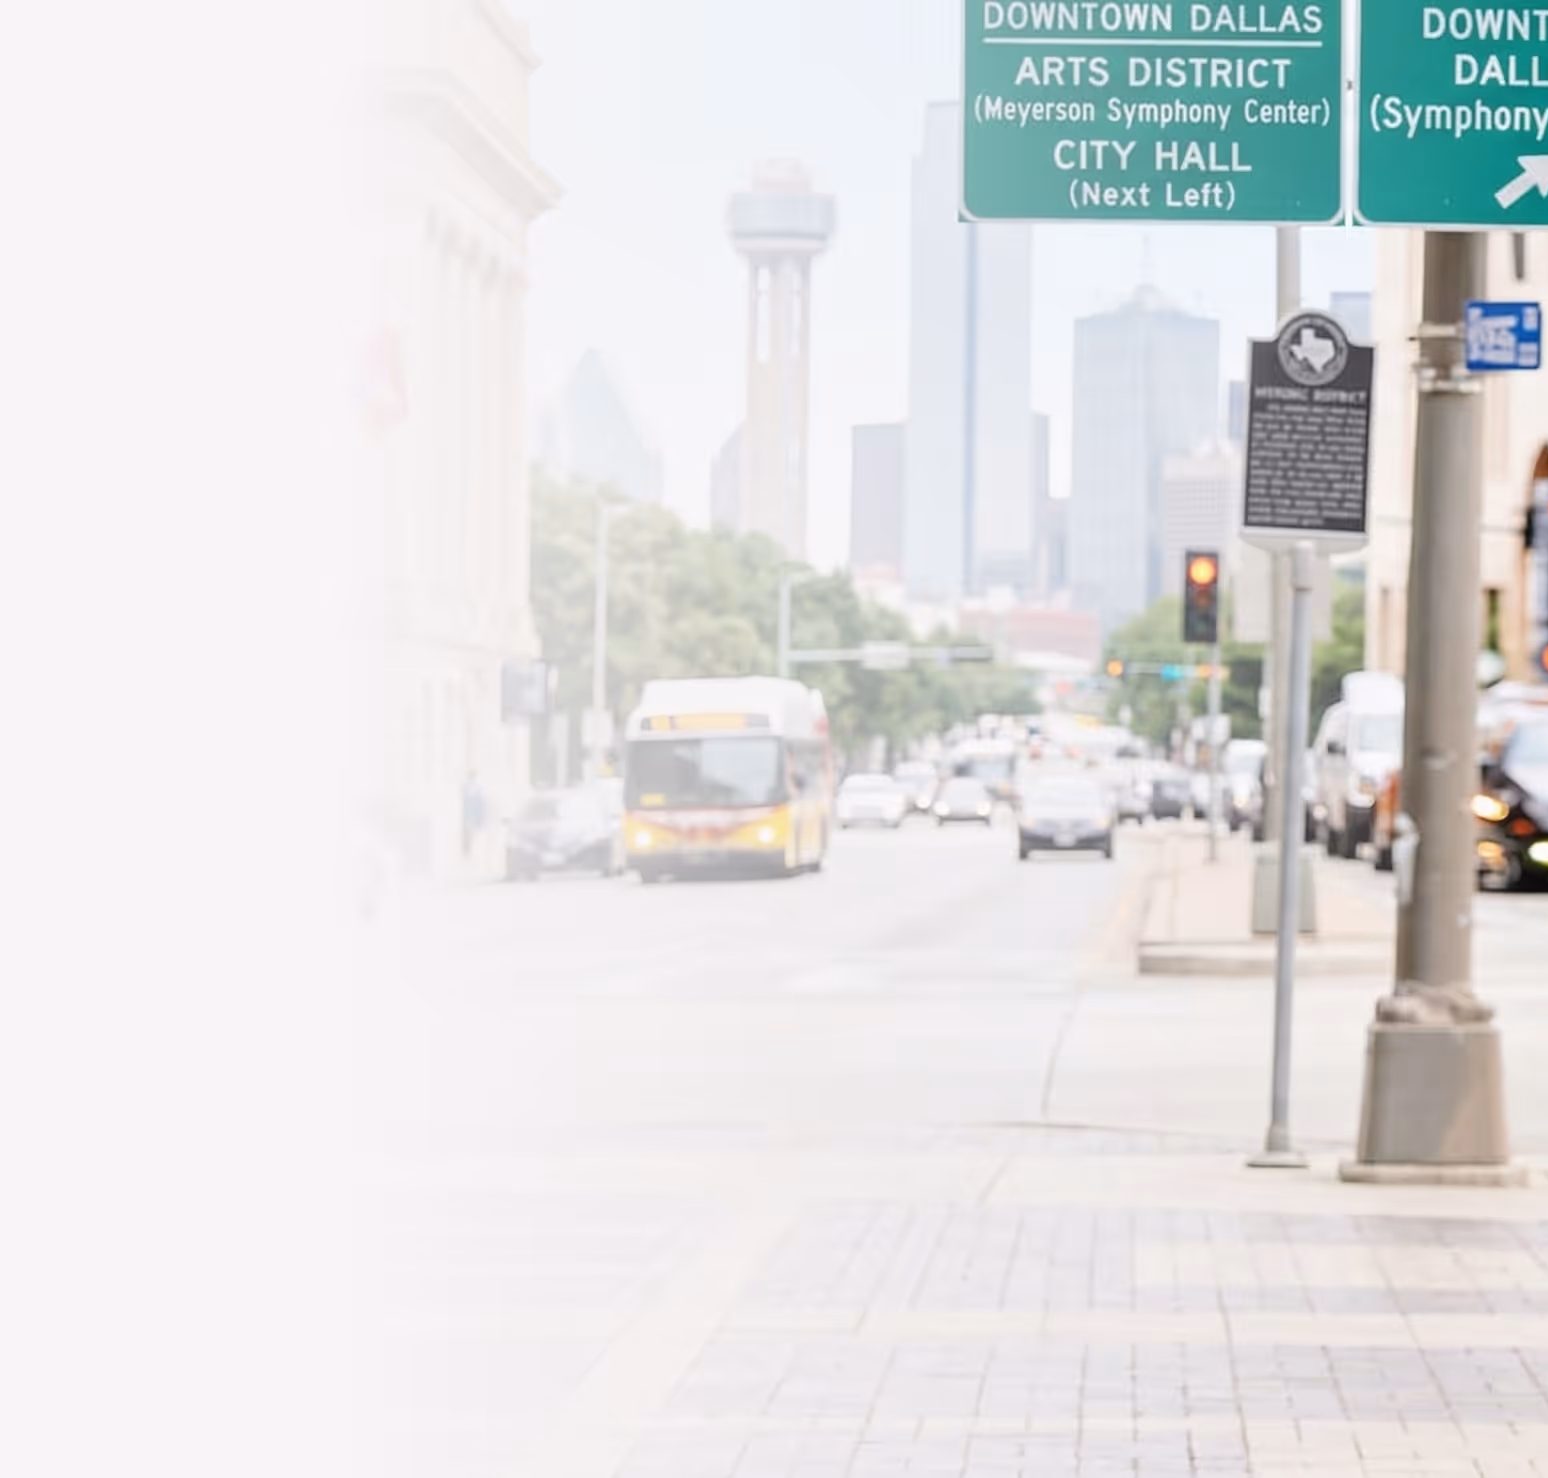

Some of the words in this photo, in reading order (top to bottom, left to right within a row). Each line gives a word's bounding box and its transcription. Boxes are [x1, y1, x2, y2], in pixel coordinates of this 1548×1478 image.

[984, 1, 1172, 32] DOWNTOWN
[1191, 4, 1322, 33] DALLAS
[1015, 56, 1109, 87] ARTS
[1129, 57, 1291, 88] DISTRICT
[974, 95, 1095, 127] (Meyerson
[1107, 97, 1231, 130] Symphony
[1244, 98, 1330, 126] Center)
[1053, 139, 1136, 170] CITY
[1155, 141, 1253, 172] HALL
[1069, 178, 1150, 210] (Next
[1166, 181, 1235, 211] Left)
